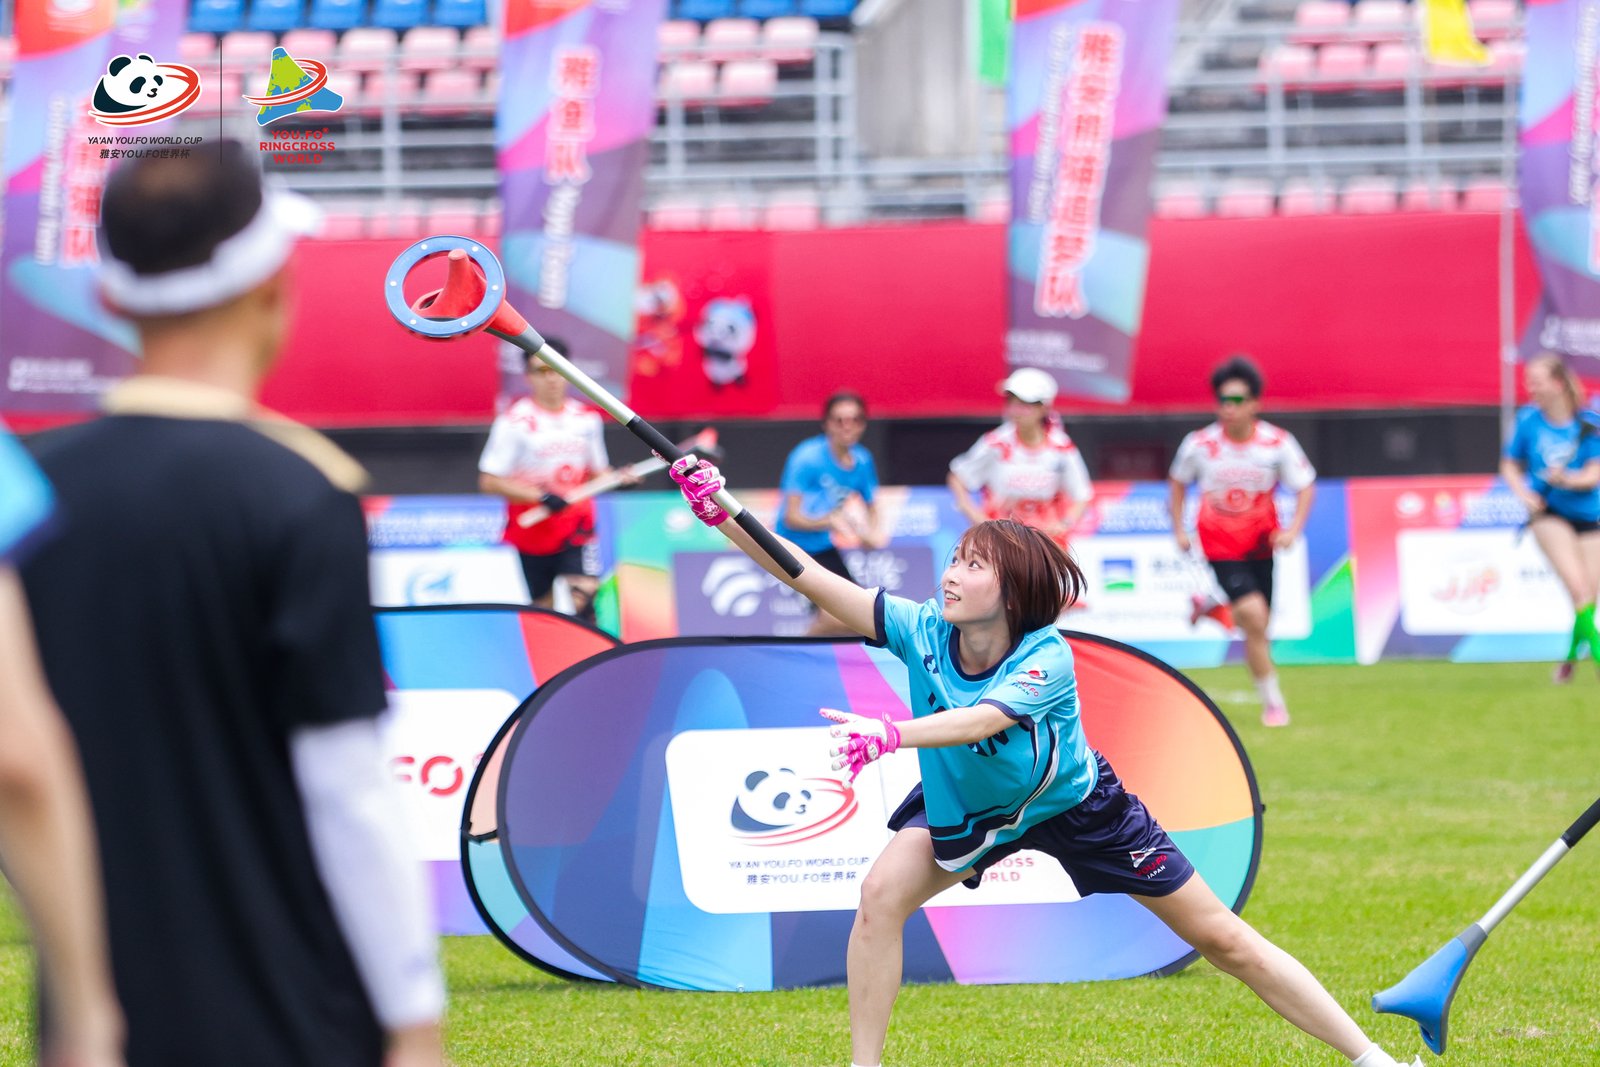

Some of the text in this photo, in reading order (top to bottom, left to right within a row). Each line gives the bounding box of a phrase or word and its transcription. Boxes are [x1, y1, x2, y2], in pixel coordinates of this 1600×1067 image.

[805, 858, 845, 867] WORLD
[847, 856, 870, 866] CUP
[1146, 864, 1166, 879] JAPAN
